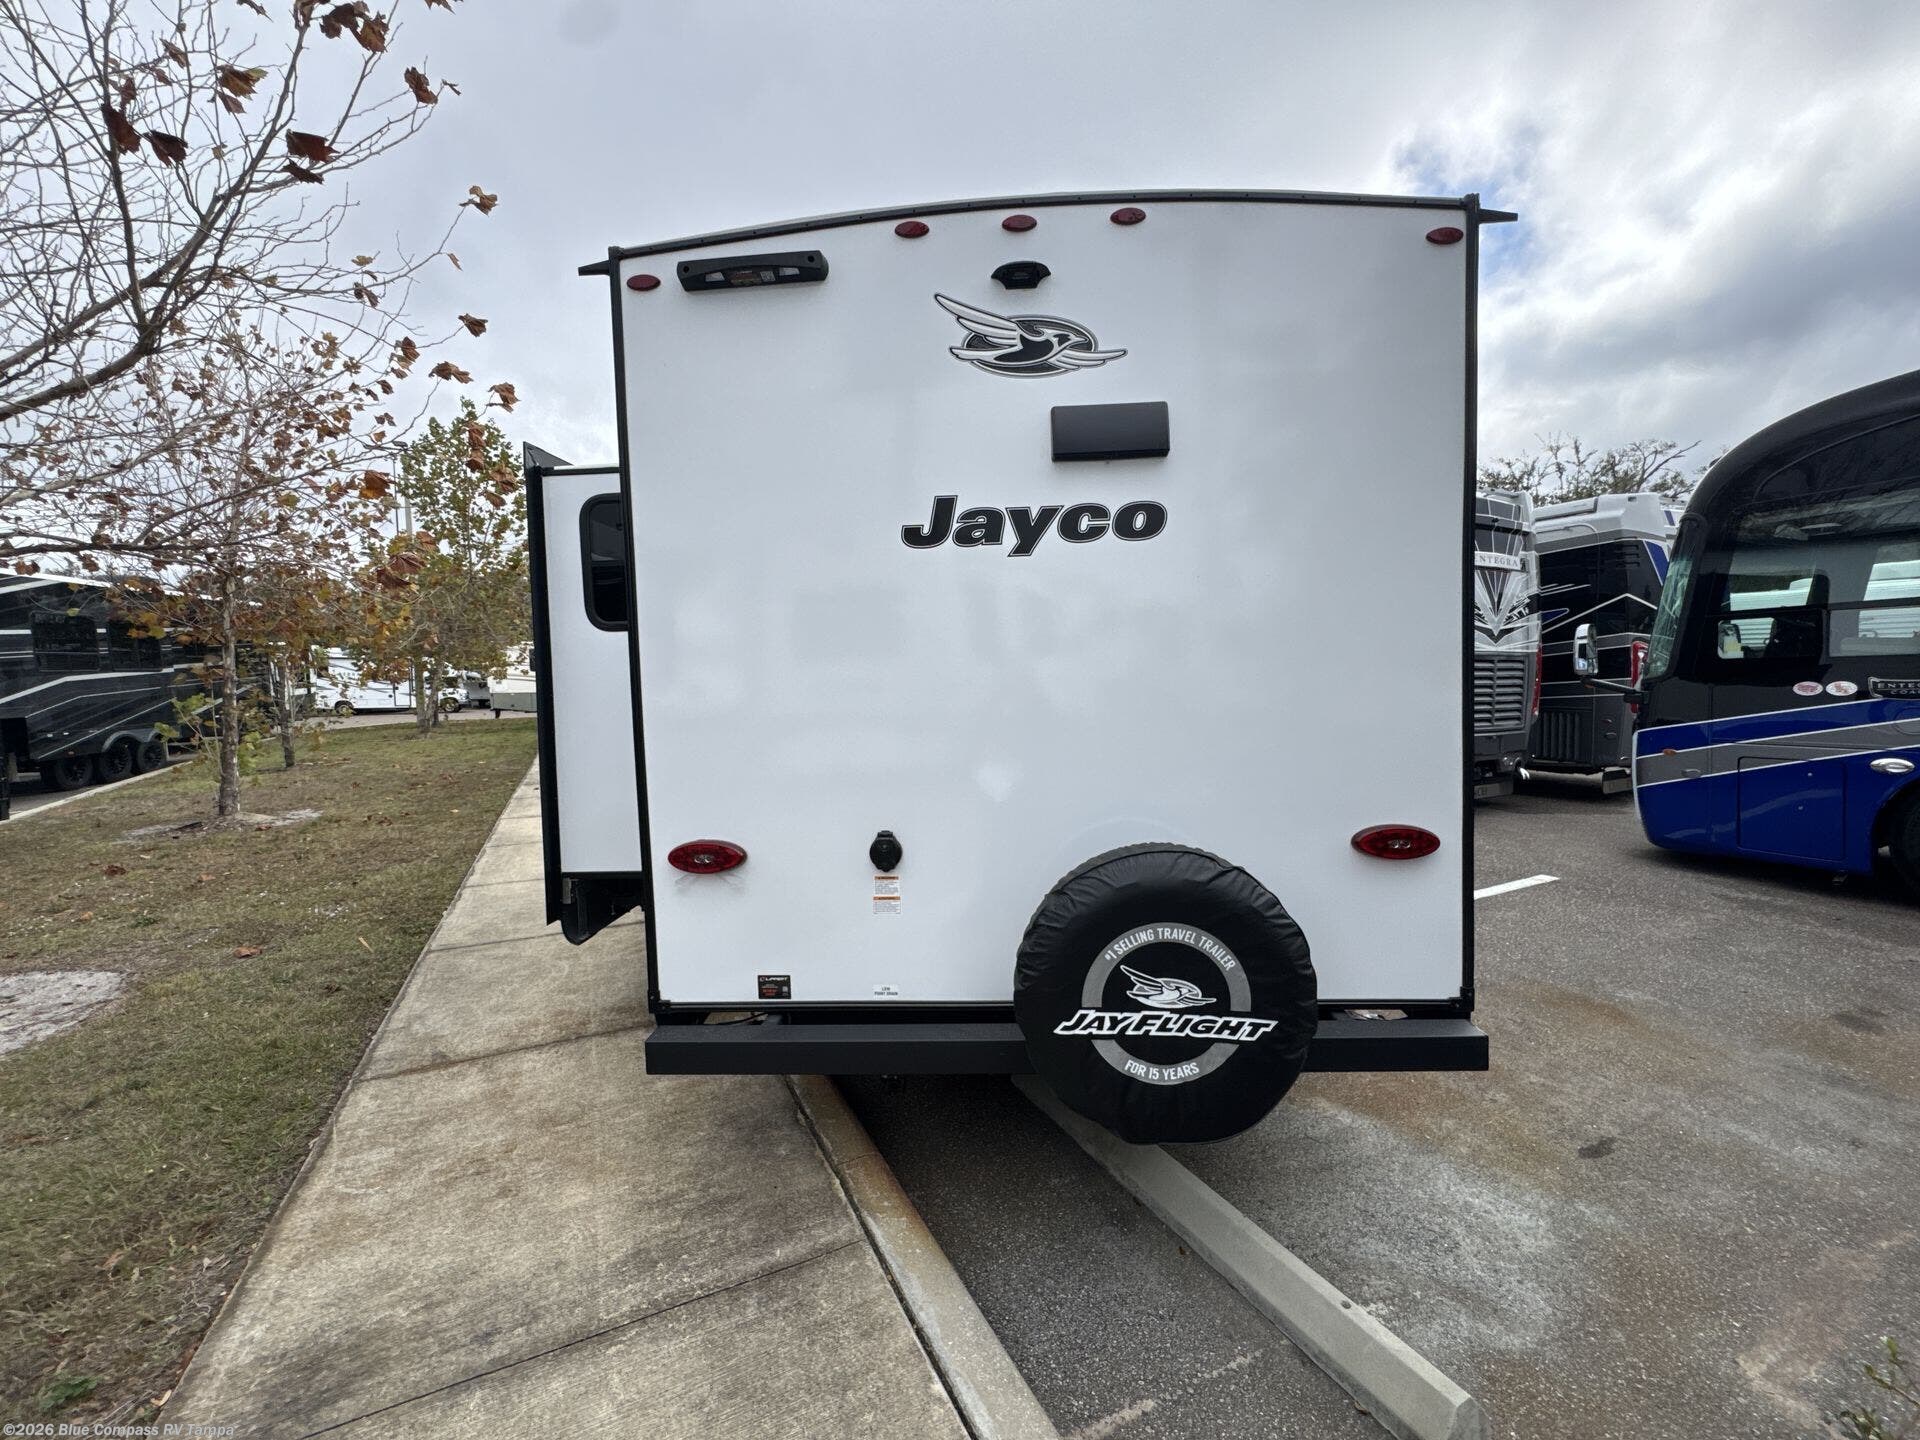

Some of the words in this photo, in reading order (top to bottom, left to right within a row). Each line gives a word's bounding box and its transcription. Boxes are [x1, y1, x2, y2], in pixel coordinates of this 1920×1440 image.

[901, 495, 1168, 557] Jayco
[1475, 554, 1519, 567] NTEGRA
[1113, 929, 1155, 955] SELLING
[1157, 928, 1195, 945] TRAVEL
[1199, 936, 1236, 971] TRAILER
[1124, 1059, 1146, 1077] FOR
[1148, 1067, 1160, 1080] 15
[1162, 1062, 1200, 1080] YEARS
